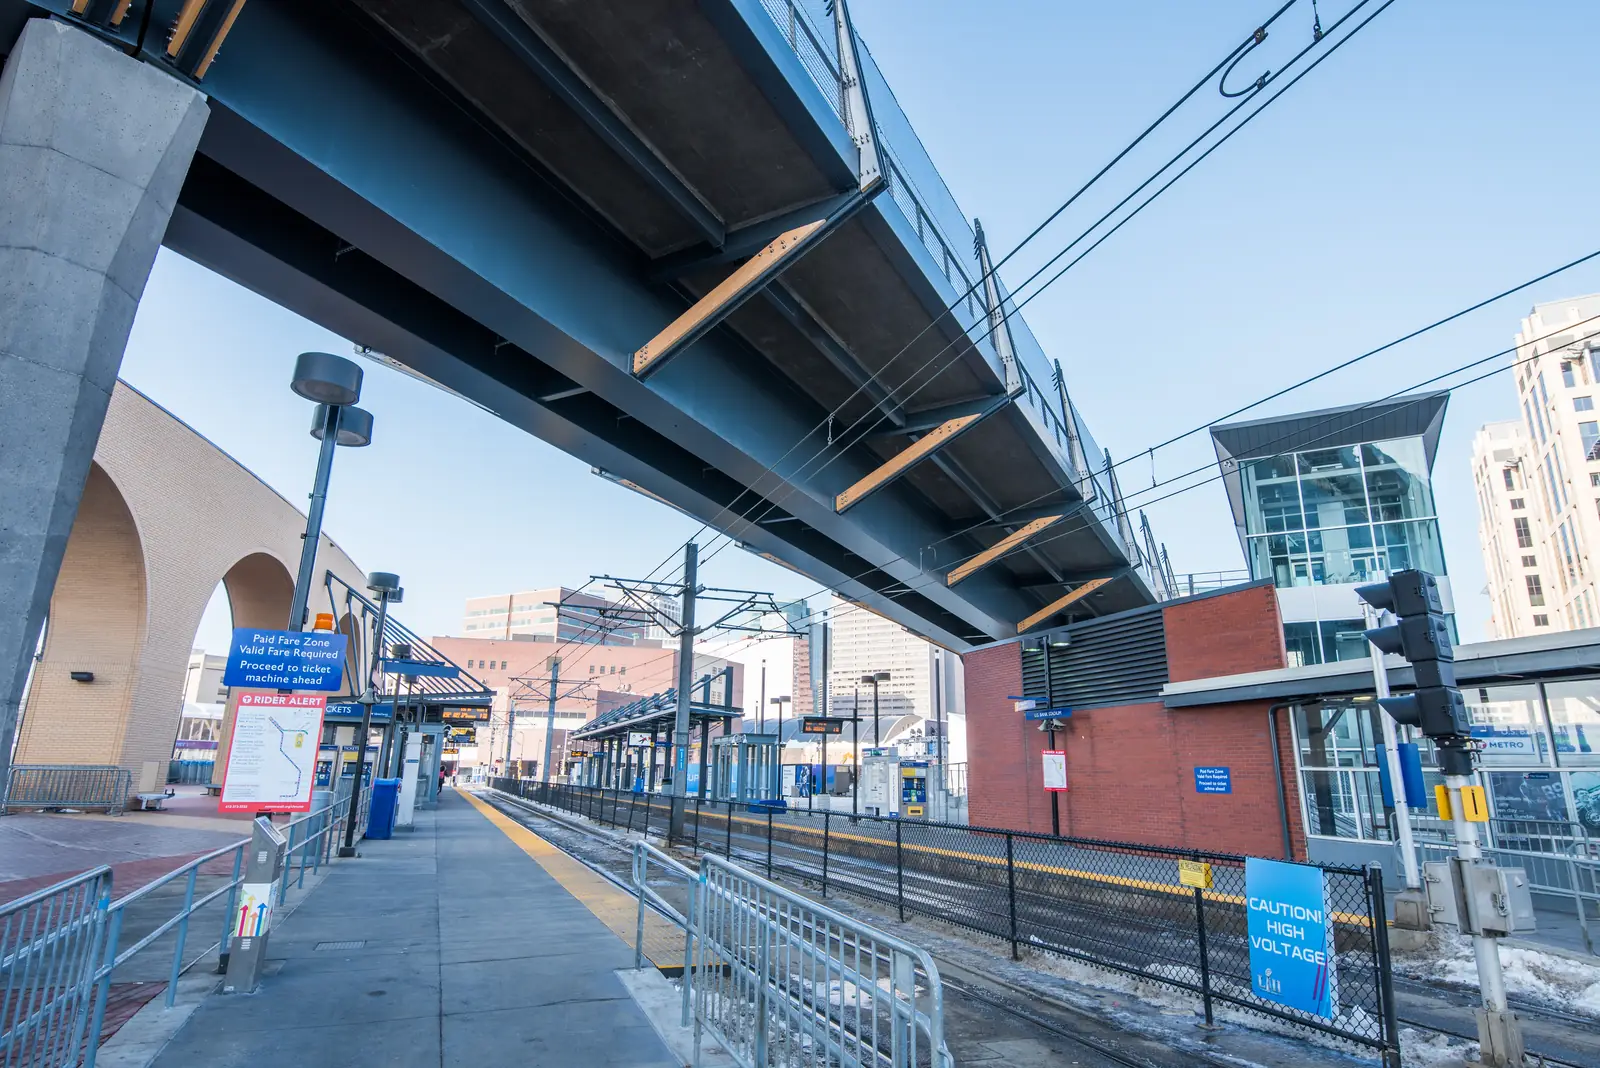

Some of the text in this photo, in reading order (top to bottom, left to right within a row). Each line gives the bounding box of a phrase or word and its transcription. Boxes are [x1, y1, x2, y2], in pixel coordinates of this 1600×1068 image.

[253, 634, 330, 647] Paid Fare Zone
[239, 645, 339, 660] Valid Fare Required
[239, 660, 331, 674] Proceed to ticket
[245, 674, 323, 685] machine ahead
[253, 695, 288, 705] RIDER
[288, 697, 322, 706] ALERT
[326, 705, 352, 713] CKETS
[1489, 741, 1524, 749] METRO
[1249, 897, 1323, 924] CAUTION!
[1266, 919, 1305, 941] HIGH
[1251, 935, 1326, 966] VOLTAGE
